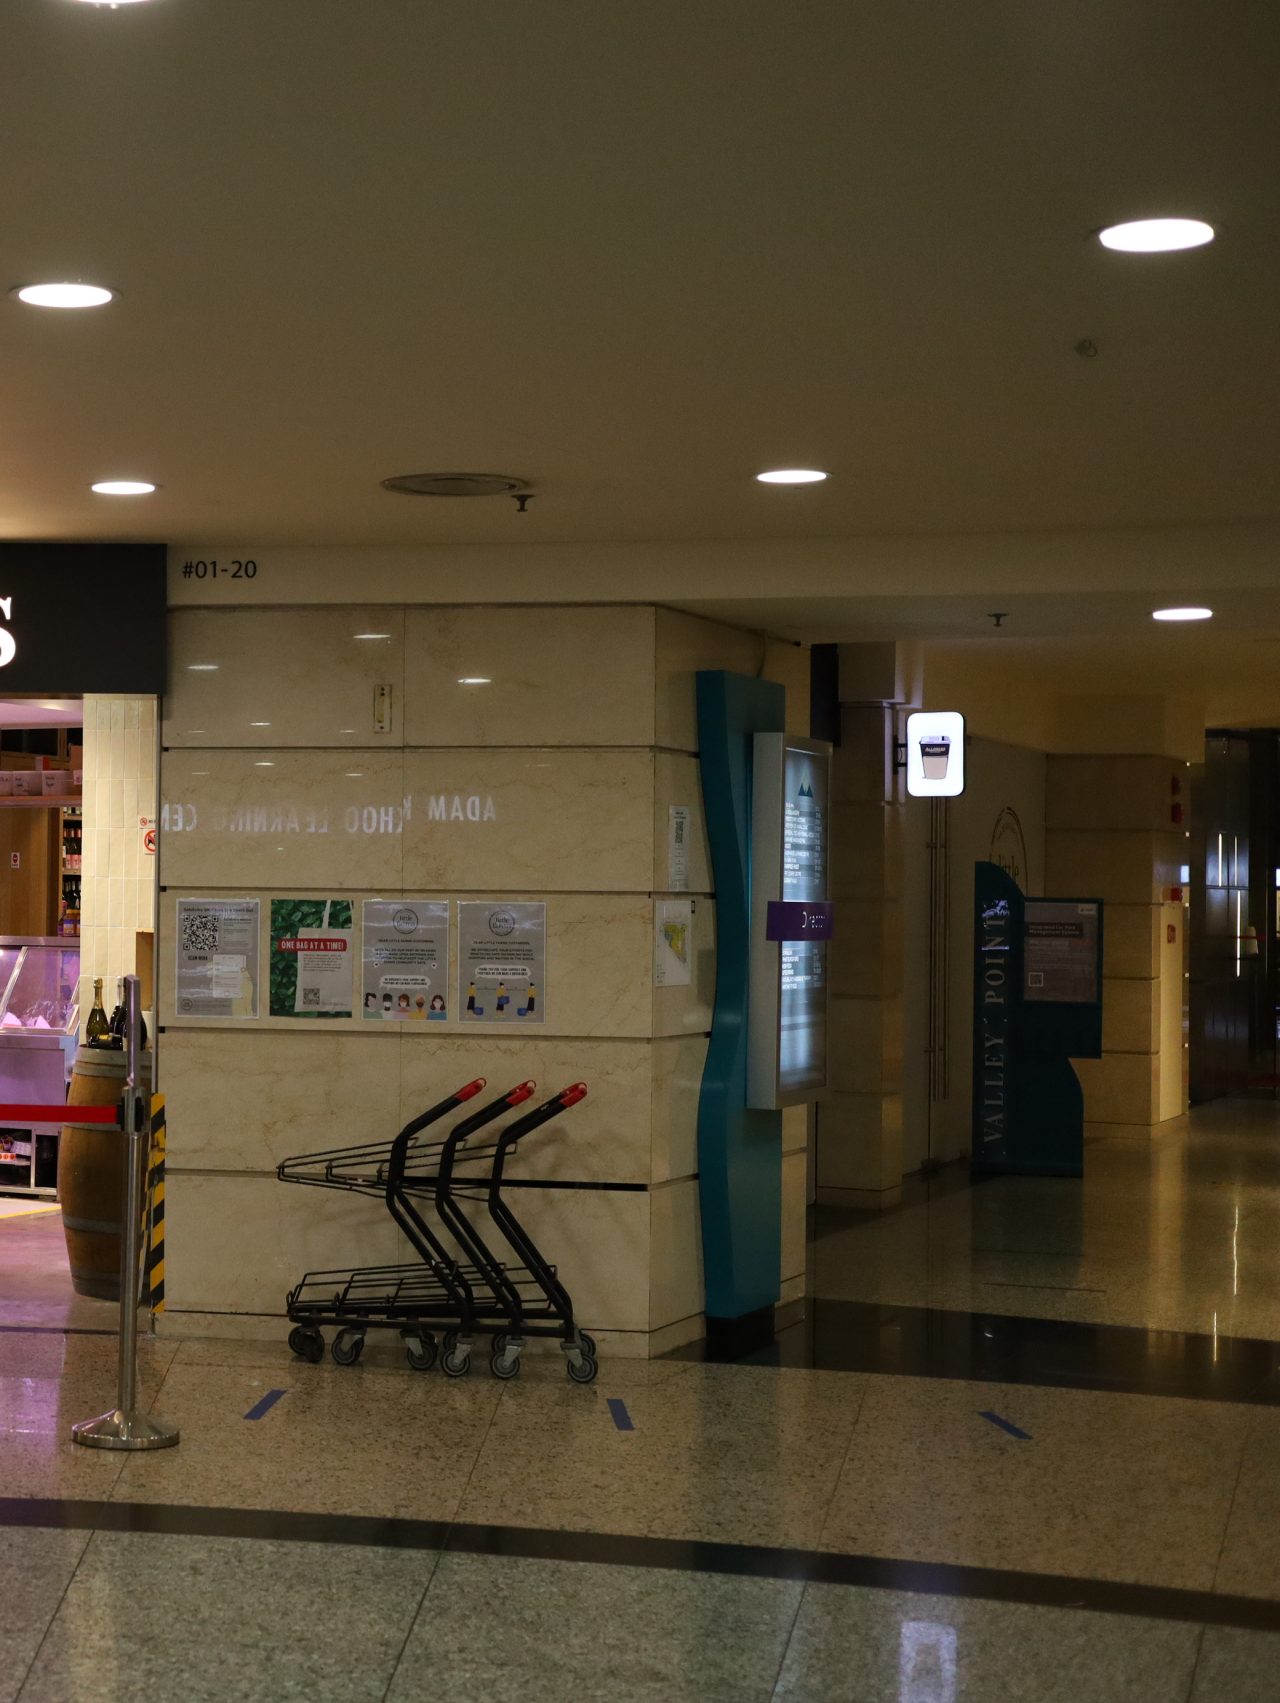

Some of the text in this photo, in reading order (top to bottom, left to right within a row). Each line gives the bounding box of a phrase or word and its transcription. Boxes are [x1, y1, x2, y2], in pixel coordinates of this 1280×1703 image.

[182, 560, 258, 579] #01-20
[281, 940, 295, 949] ONE
[984, 914, 1005, 1005] POINT
[984, 1033, 1005, 1143] VALLEY
